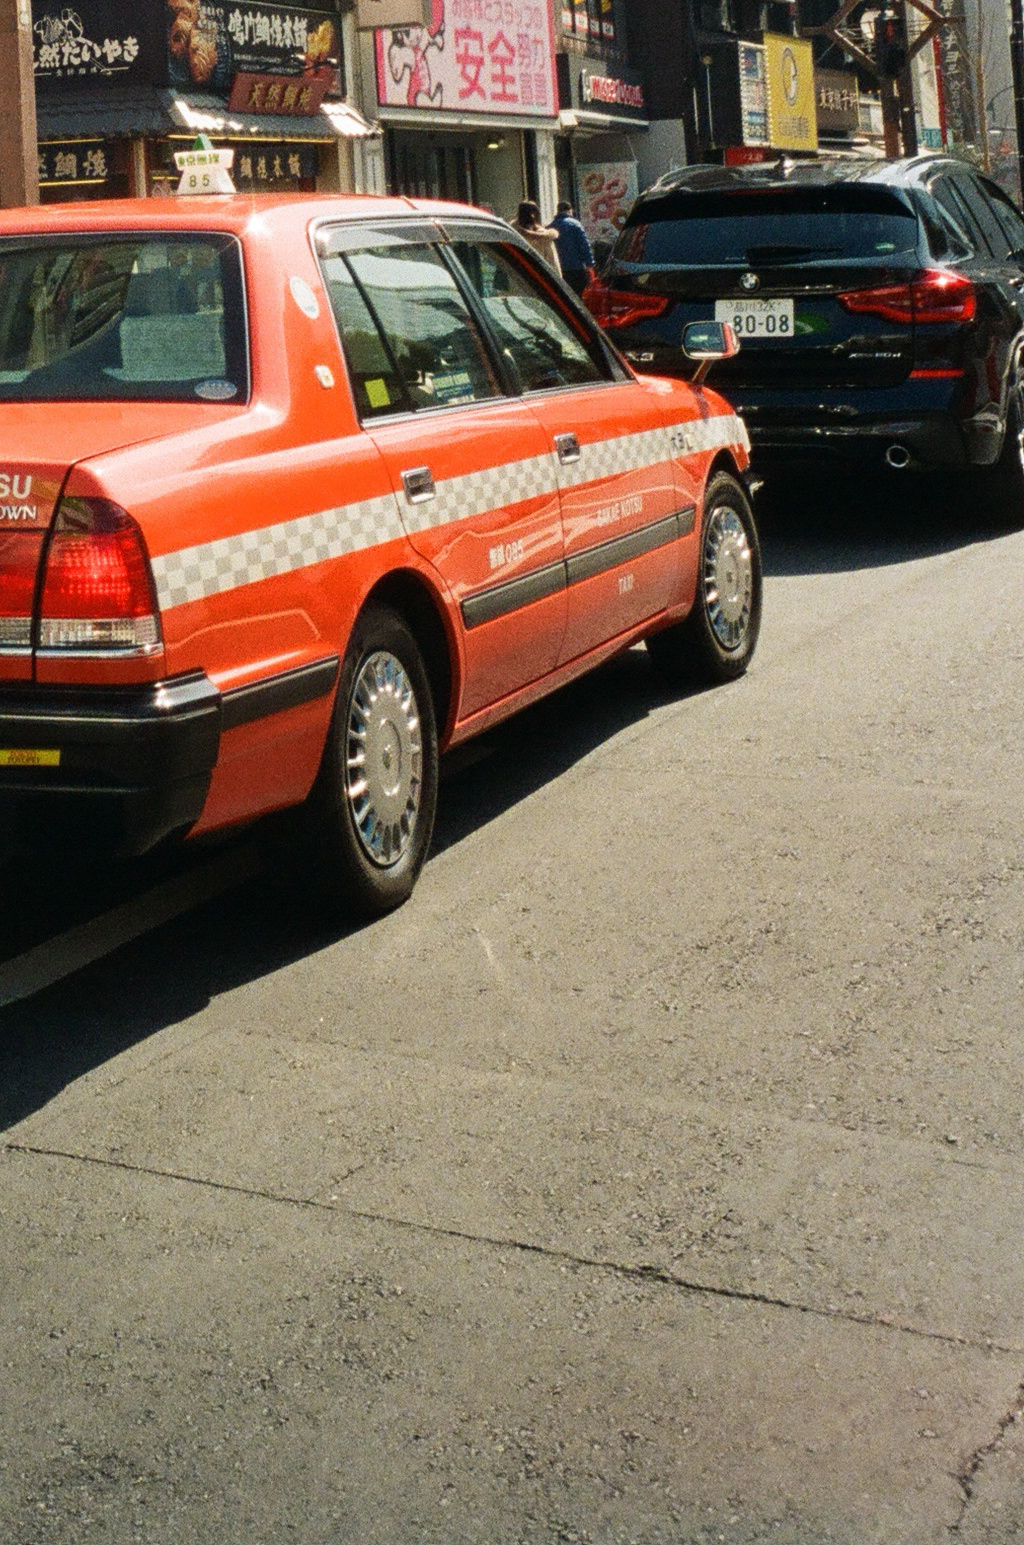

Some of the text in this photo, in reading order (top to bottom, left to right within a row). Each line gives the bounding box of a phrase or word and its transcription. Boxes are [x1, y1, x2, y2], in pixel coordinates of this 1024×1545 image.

[33, 36, 140, 69] 然たいやき
[453, 25, 519, 103] 安全
[732, 314, 790, 334] 80-08
